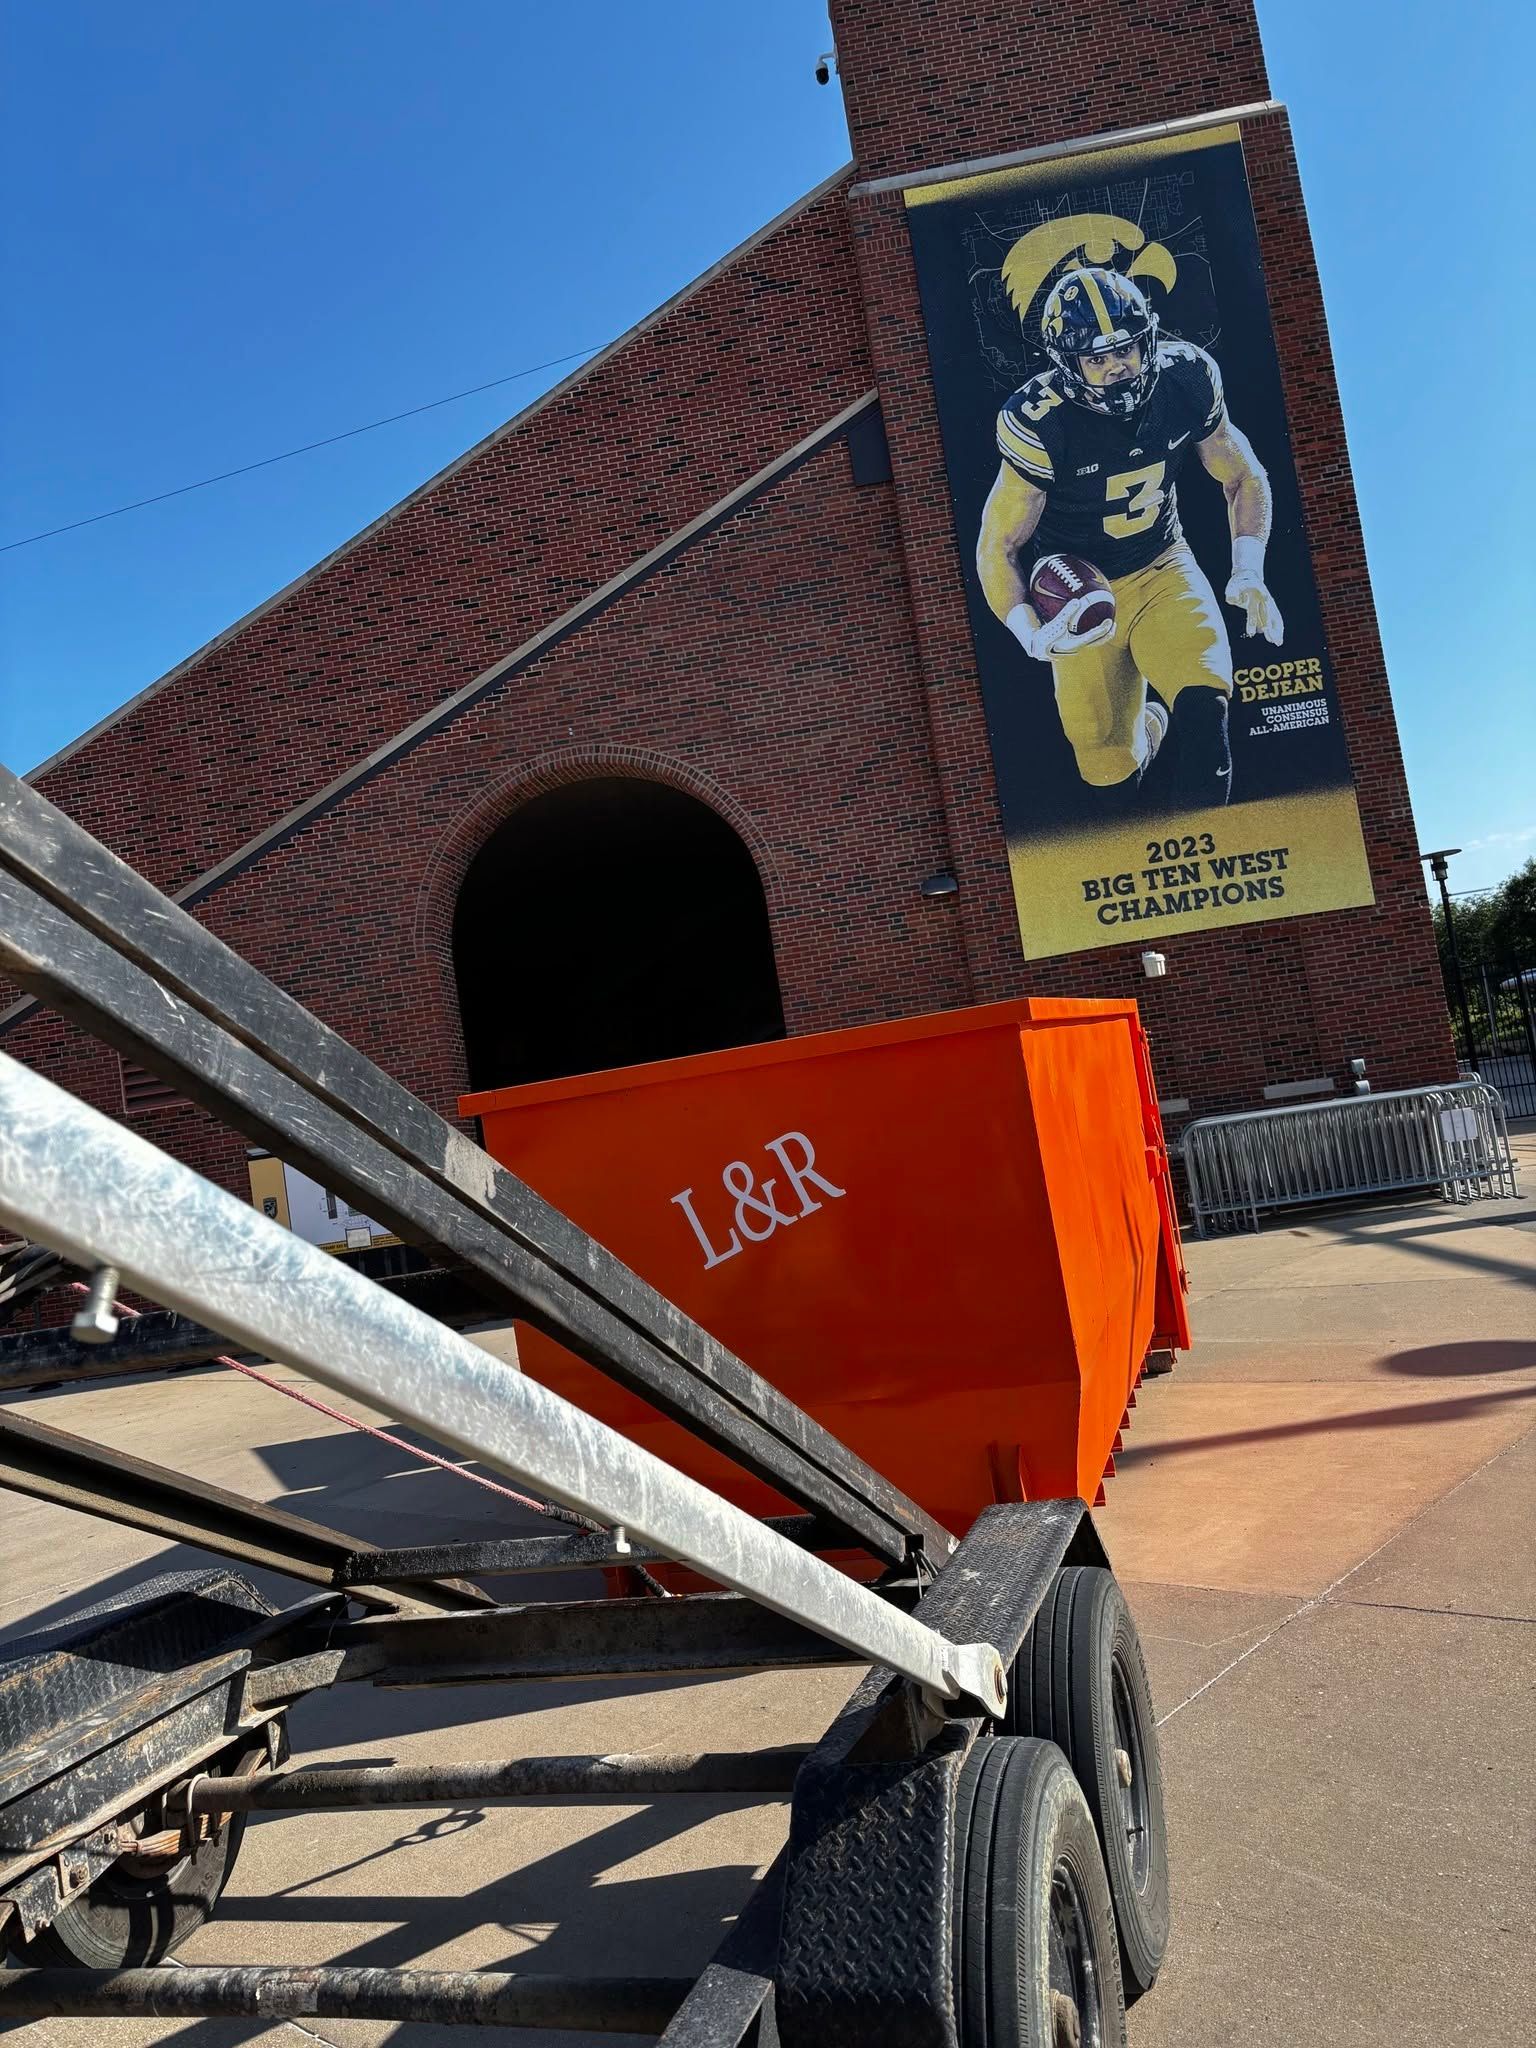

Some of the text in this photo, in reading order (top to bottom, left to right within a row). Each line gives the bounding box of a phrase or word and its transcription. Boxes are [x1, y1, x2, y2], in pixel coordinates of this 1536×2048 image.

[1102, 460, 1166, 539] 3
[1233, 657, 1322, 686] COOPER
[1240, 674, 1324, 703] DEJEAN
[1260, 698, 1328, 717] UNANIMOUS
[1265, 706, 1329, 724] CONSENSUS
[1248, 715, 1330, 737] ALL-AMERICAN
[1146, 832, 1216, 864] 2023
[1081, 847, 1289, 902] BIG TEN WEST
[1096, 875, 1285, 926] CHAMPIONS
[670, 1131, 847, 1270] L&R
